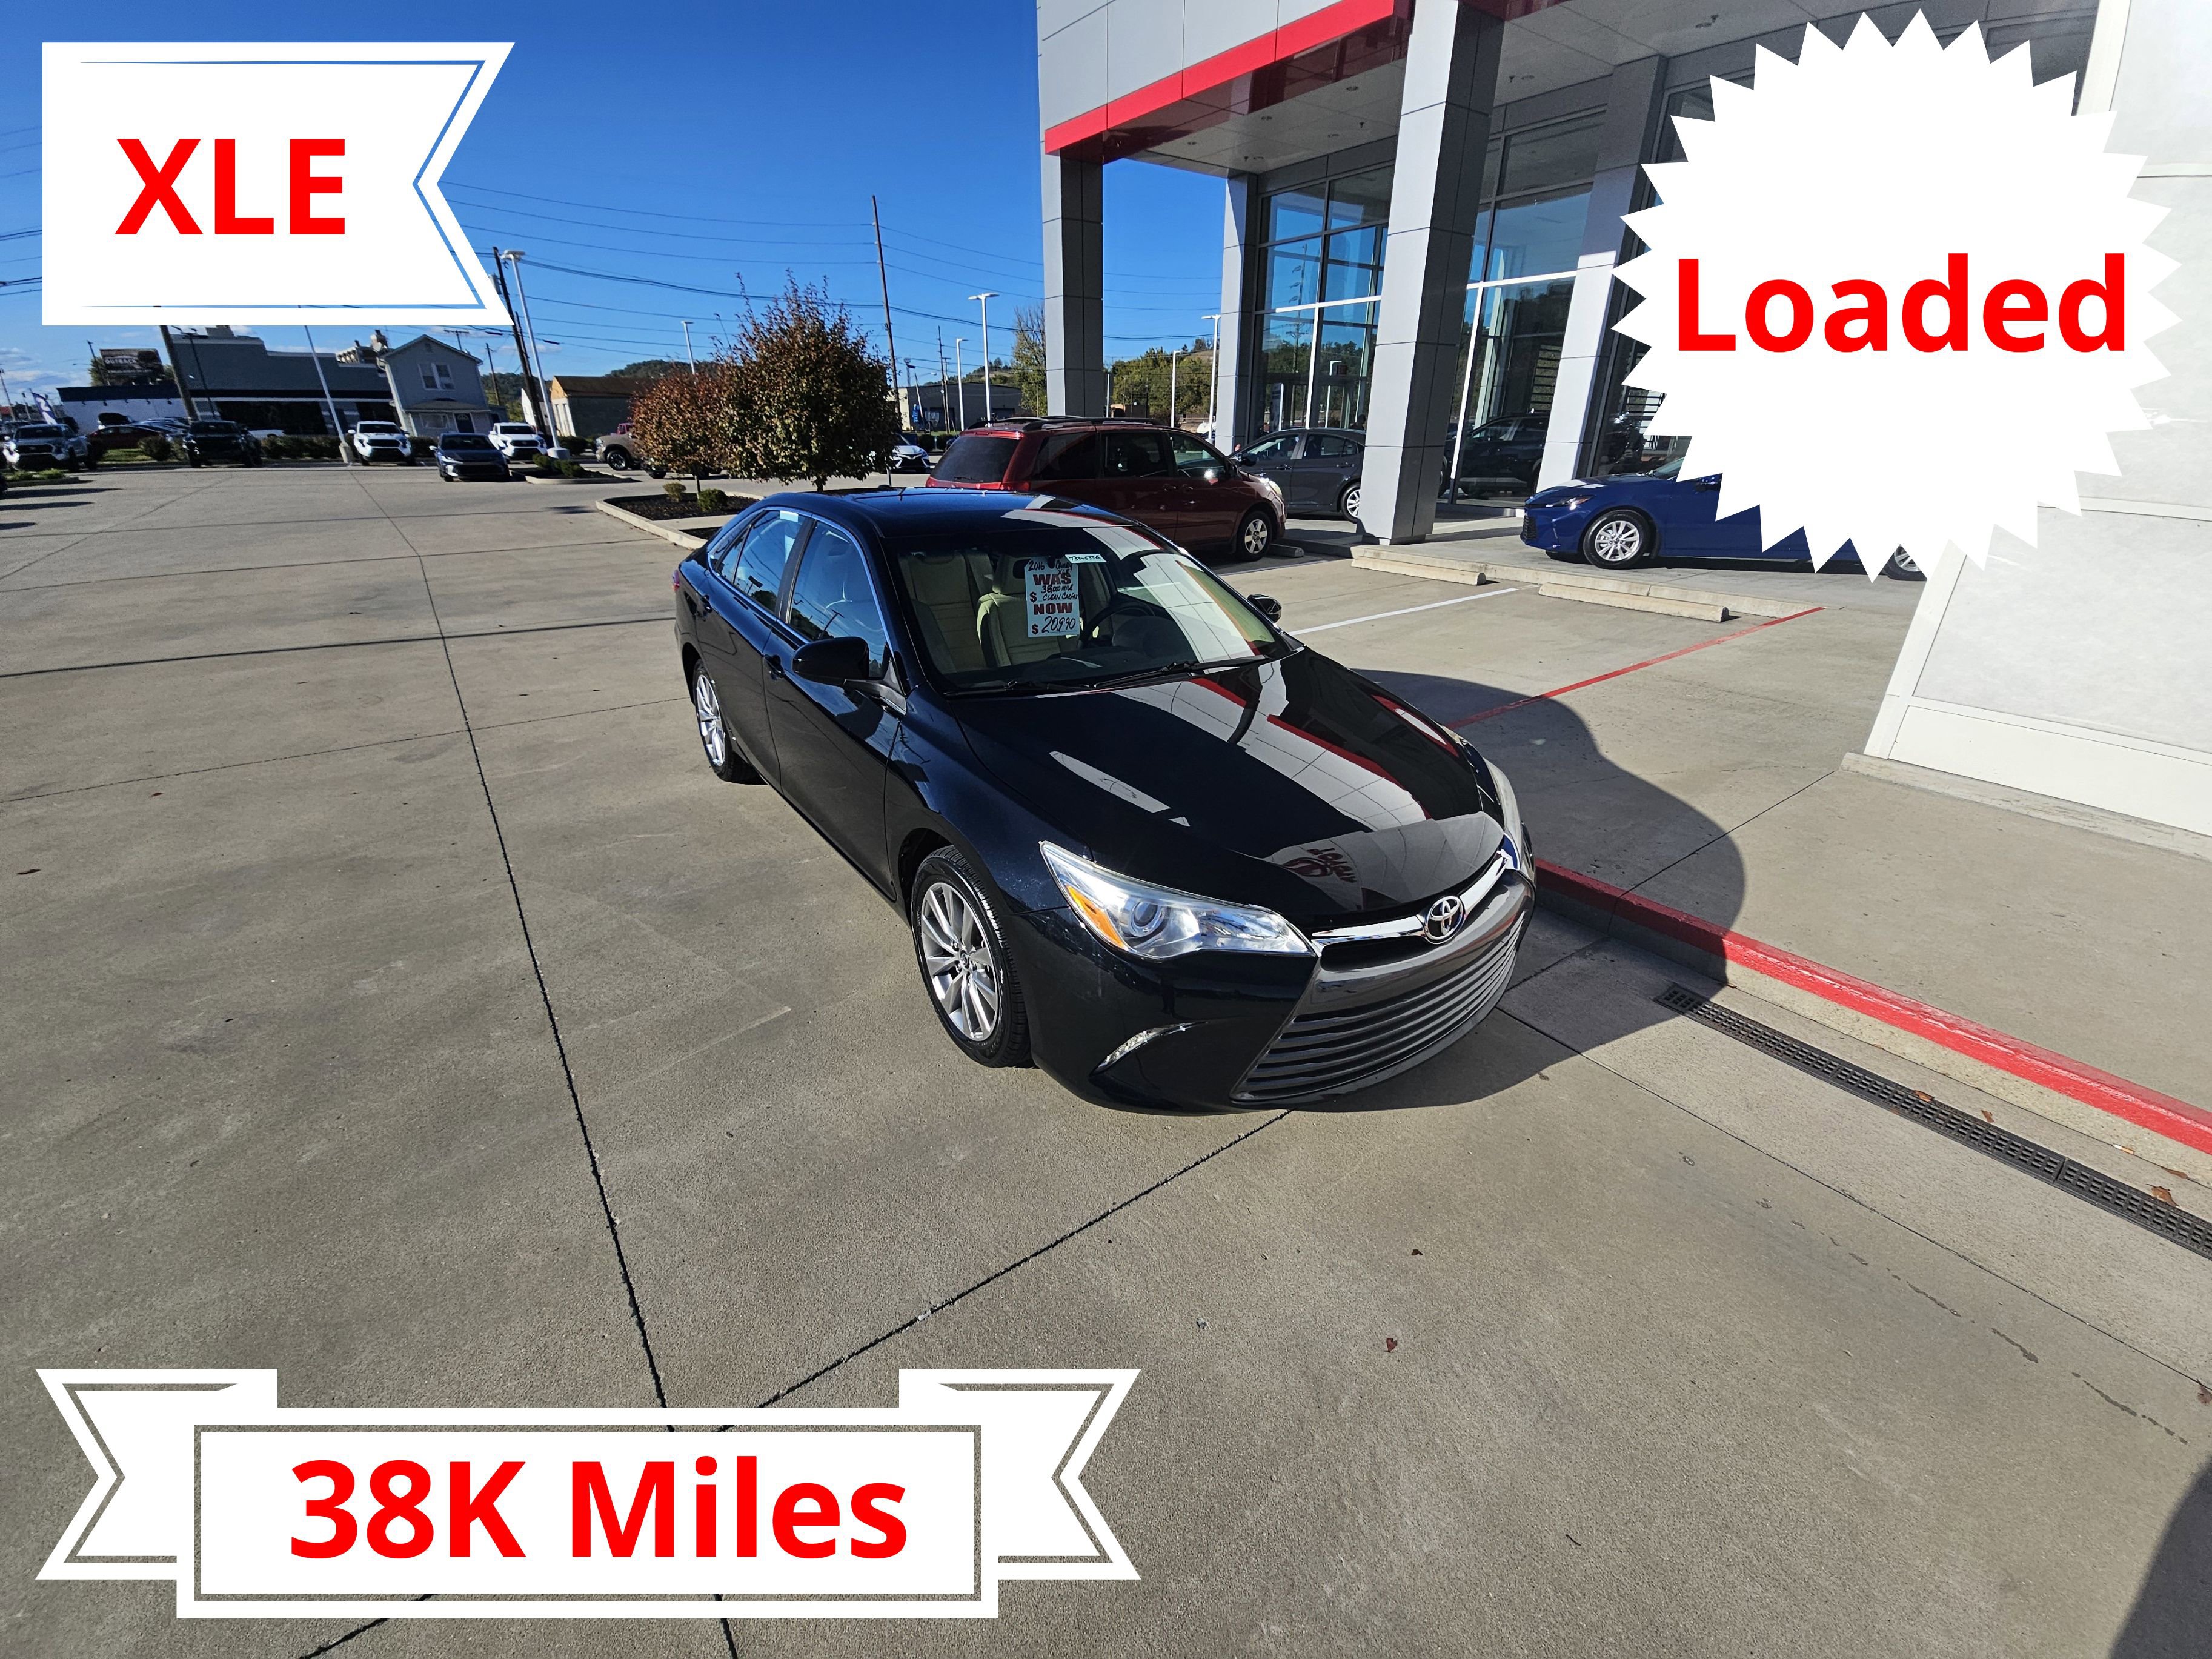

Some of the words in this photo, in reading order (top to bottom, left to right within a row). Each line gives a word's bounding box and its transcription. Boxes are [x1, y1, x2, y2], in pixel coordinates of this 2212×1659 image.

[1028, 560, 1045, 571] 2016
[1033, 574, 1072, 586] WAS
[1030, 591, 1037, 603] $
[1034, 602, 1072, 615] NOW
[1032, 623, 1038, 634] $
